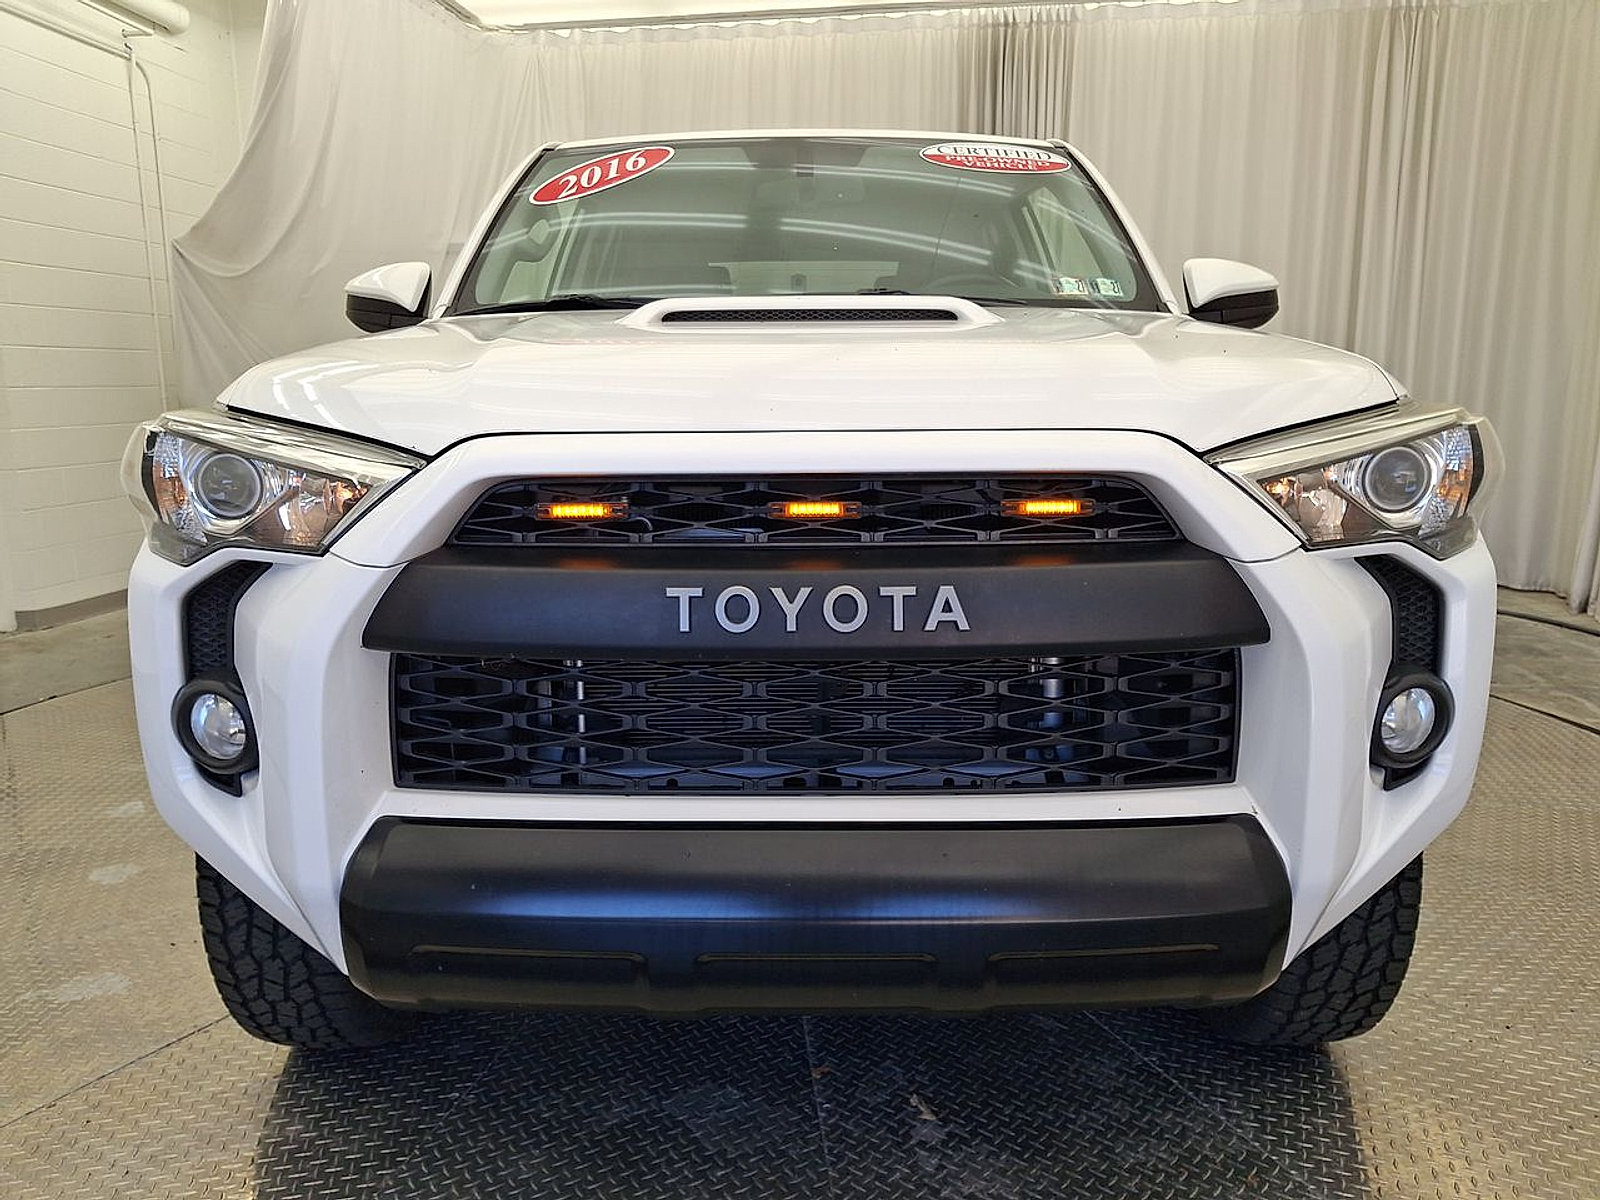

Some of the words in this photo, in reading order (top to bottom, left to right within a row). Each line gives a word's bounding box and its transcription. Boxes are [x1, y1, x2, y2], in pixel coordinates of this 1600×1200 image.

[556, 150, 647, 199] 2016
[936, 145, 1052, 160] CERTIFIED
[665, 585, 971, 634] TOYOTA
